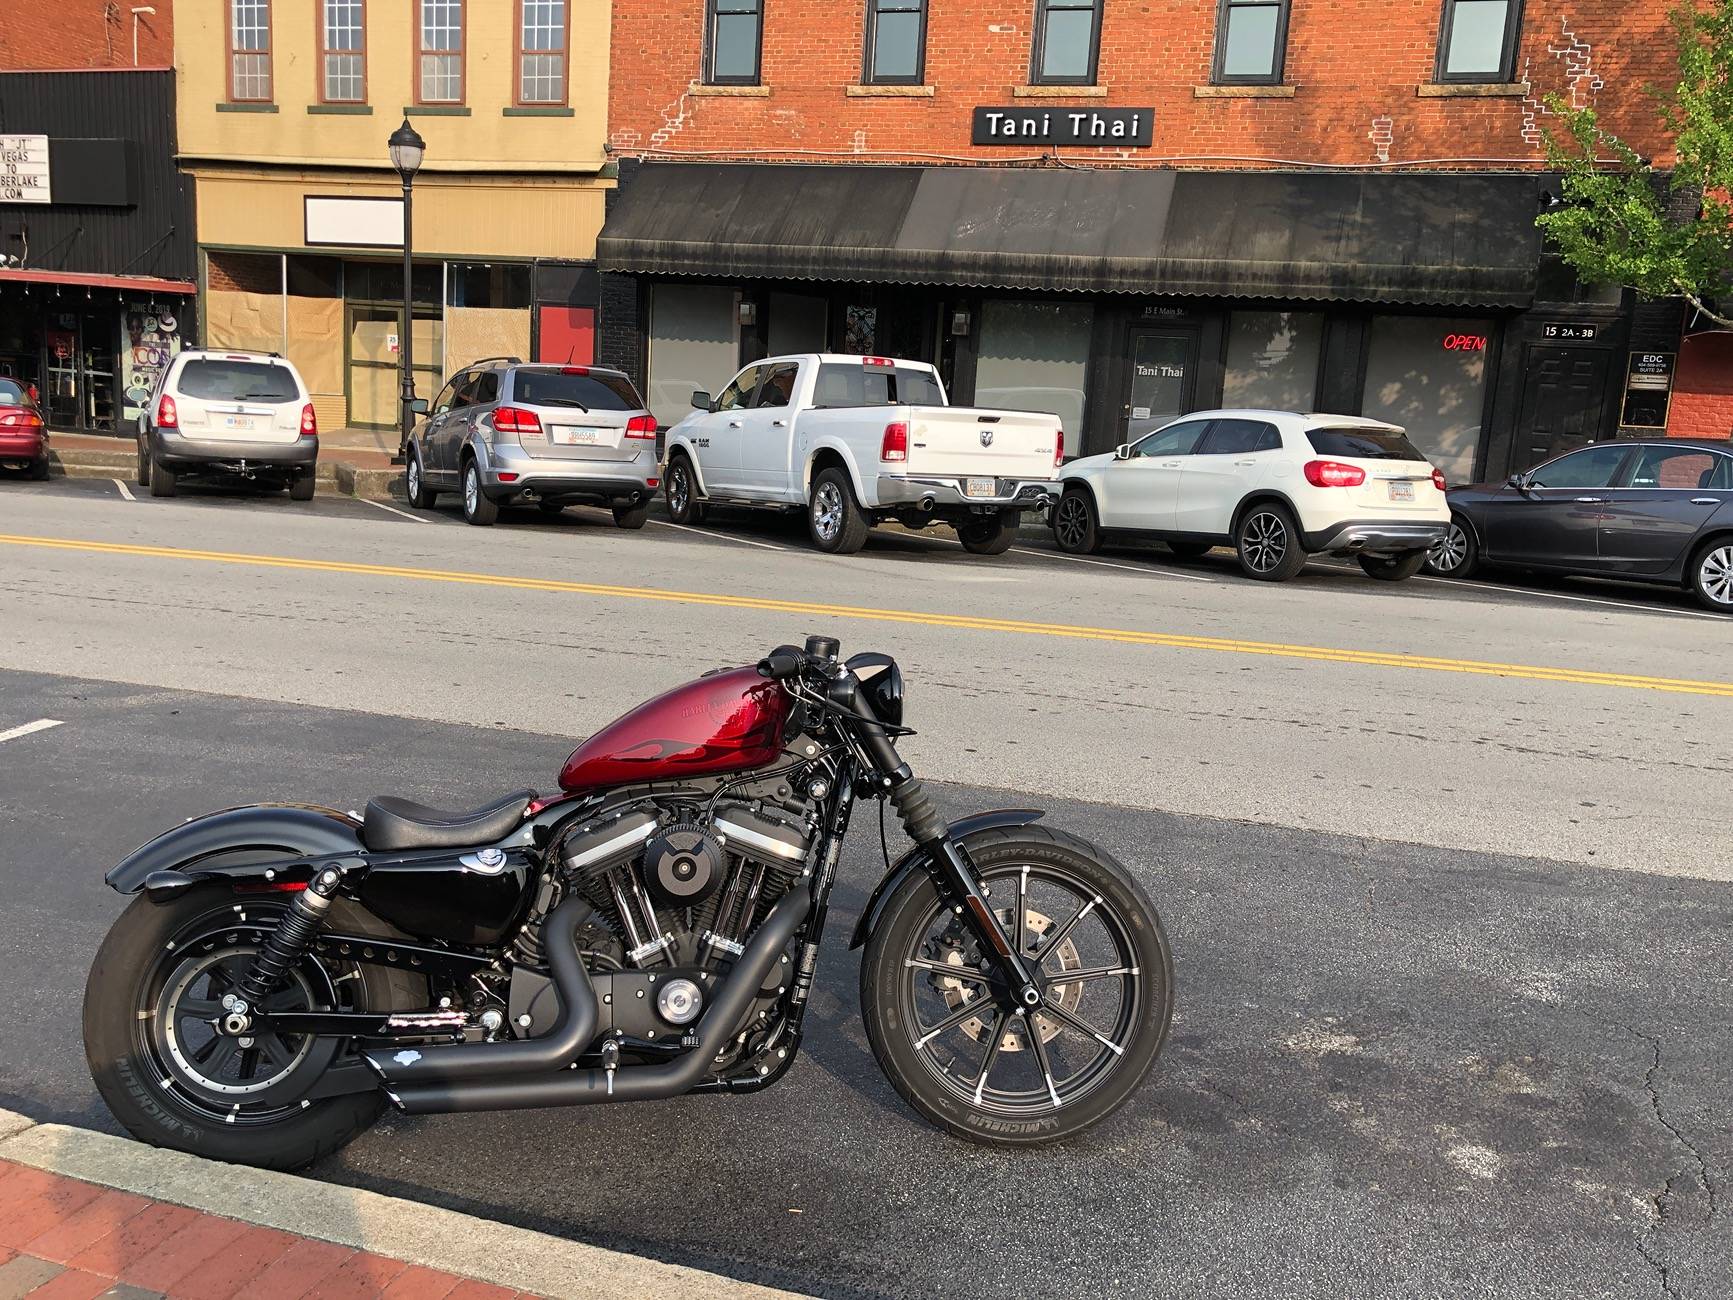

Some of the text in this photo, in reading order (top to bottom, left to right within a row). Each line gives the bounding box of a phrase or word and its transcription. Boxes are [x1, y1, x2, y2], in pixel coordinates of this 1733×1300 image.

[986, 113, 1139, 136] Tani Thai
[1, 151, 28, 162] VEGAS
[6, 163, 17, 174] TO
[0, 175, 38, 187] BERLAKE
[1545, 326, 1557, 336] 15
[1561, 328, 1574, 337] 2A
[1581, 329, 1594, 338] 3B
[1444, 334, 1486, 350] OPEN
[1642, 354, 1664, 363] EDC
[1137, 365, 1184, 377] Tani Thai
[115, 1058, 181, 1131] MICHELIN
[966, 1112, 1041, 1134] MICHELIN
